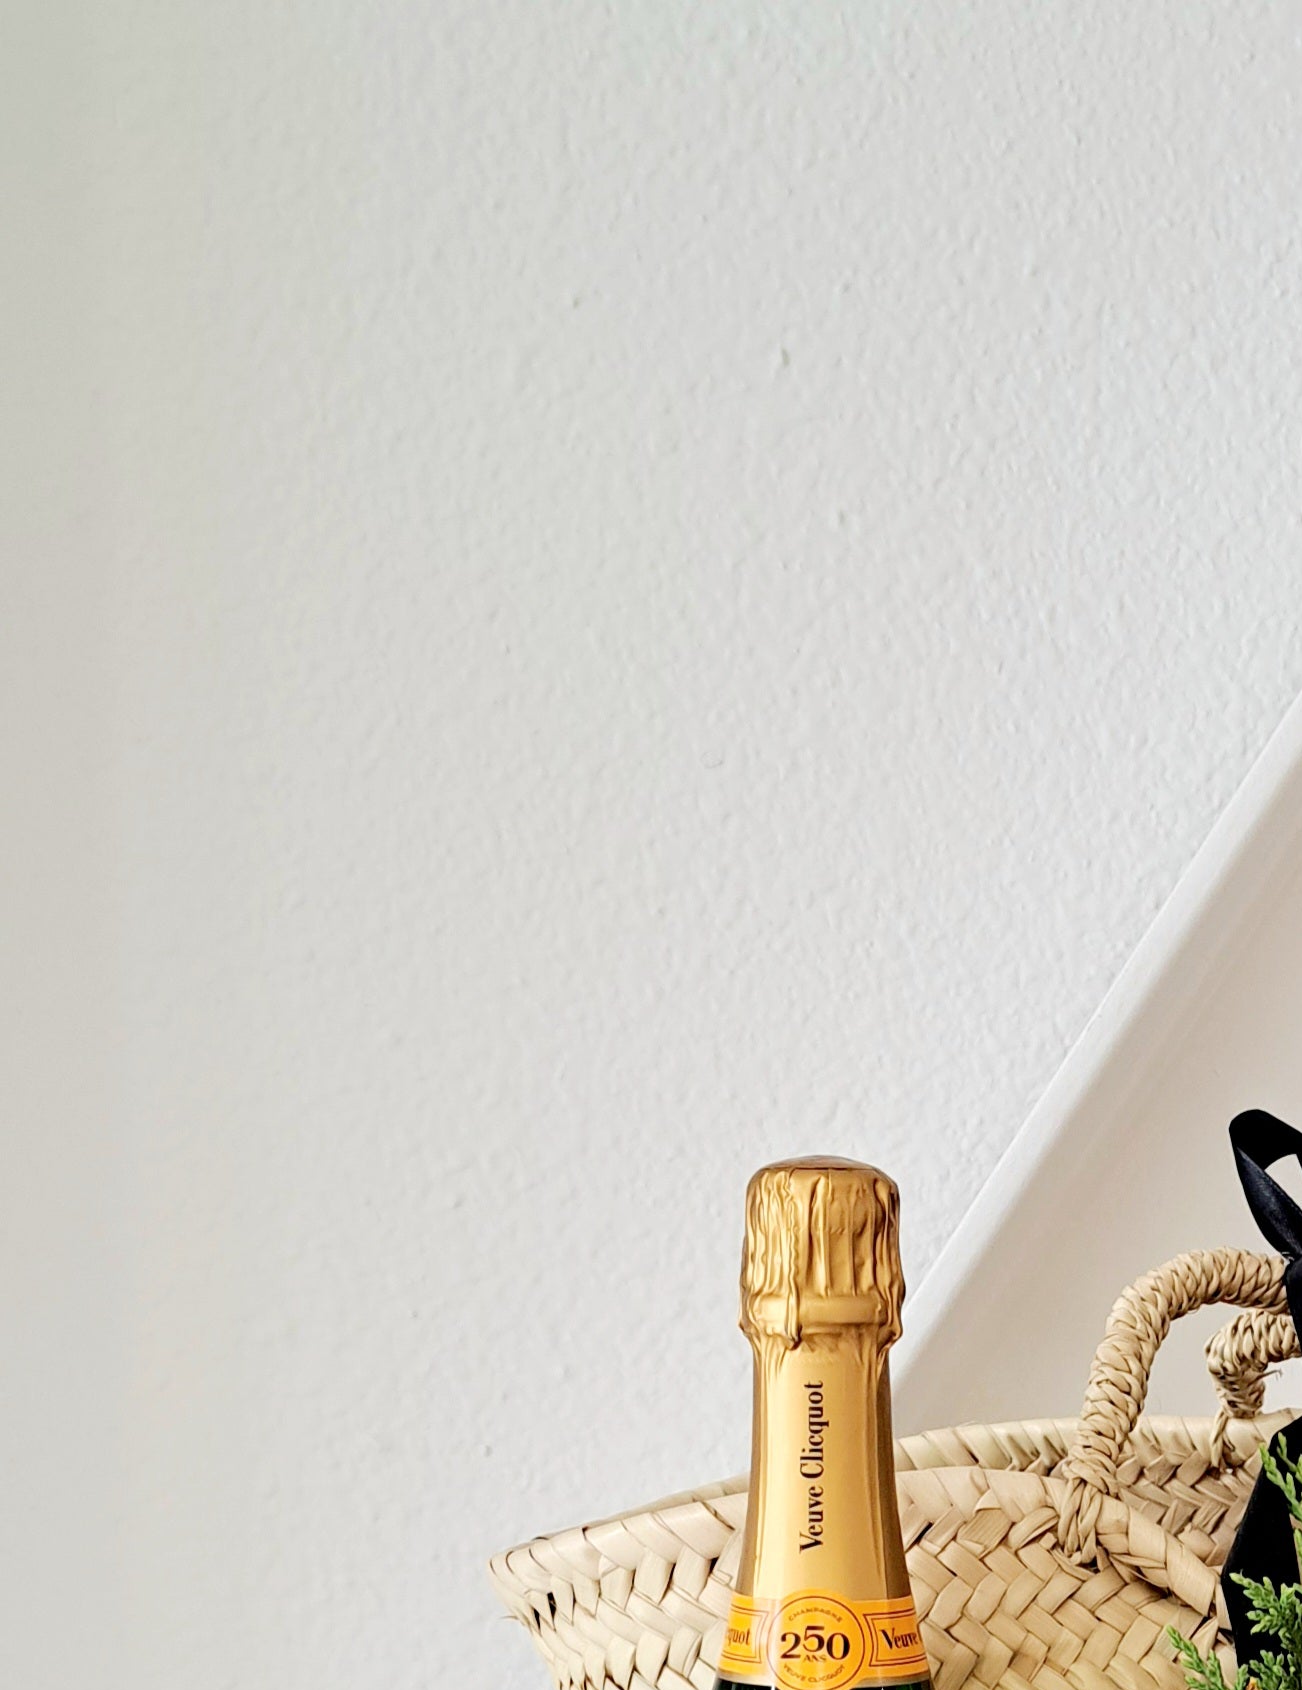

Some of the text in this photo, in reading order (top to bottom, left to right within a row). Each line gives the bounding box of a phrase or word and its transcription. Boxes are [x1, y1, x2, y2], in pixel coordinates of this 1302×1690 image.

[799, 1381, 830, 1554] Veuve Clicquot
[788, 1607, 843, 1623] CHAMPAGNE
[781, 1625, 850, 1660] 250
